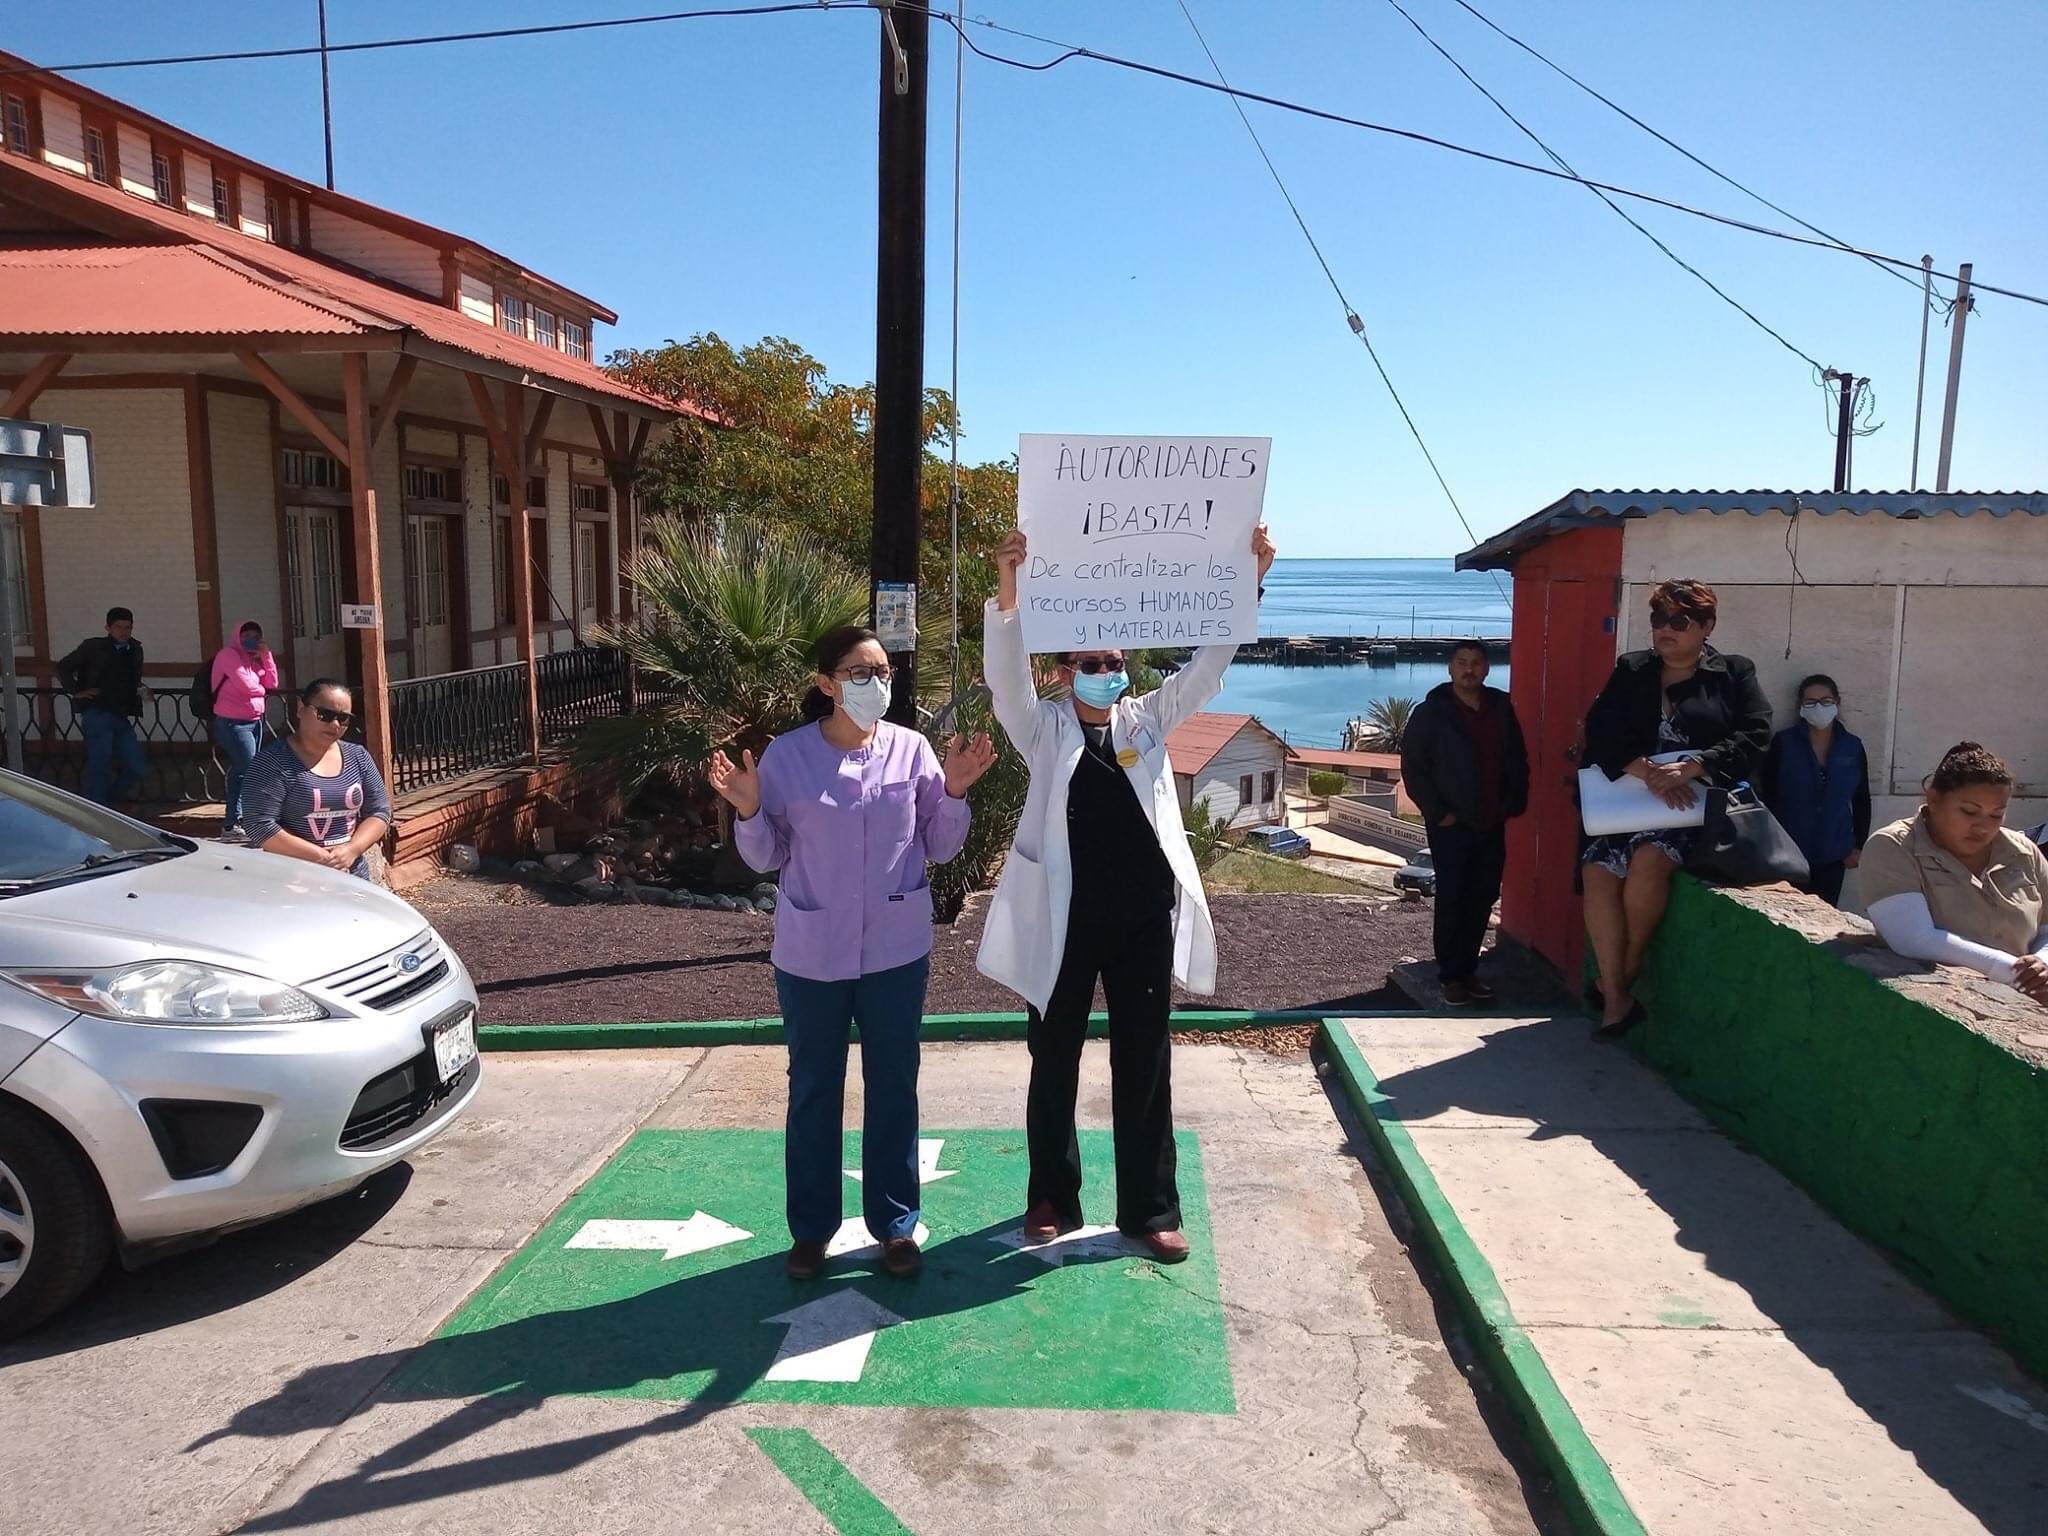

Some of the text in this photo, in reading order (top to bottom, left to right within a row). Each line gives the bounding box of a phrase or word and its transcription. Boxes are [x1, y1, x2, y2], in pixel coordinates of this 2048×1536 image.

[1055, 443, 1257, 482] AUTORIDADES
[1083, 500, 1214, 535] ¡BASTA!
[1030, 552, 1238, 581] De centralizar los
[1030, 590, 1234, 613] recursos HUMANOS
[1075, 619, 1232, 644] y MATERIALES
